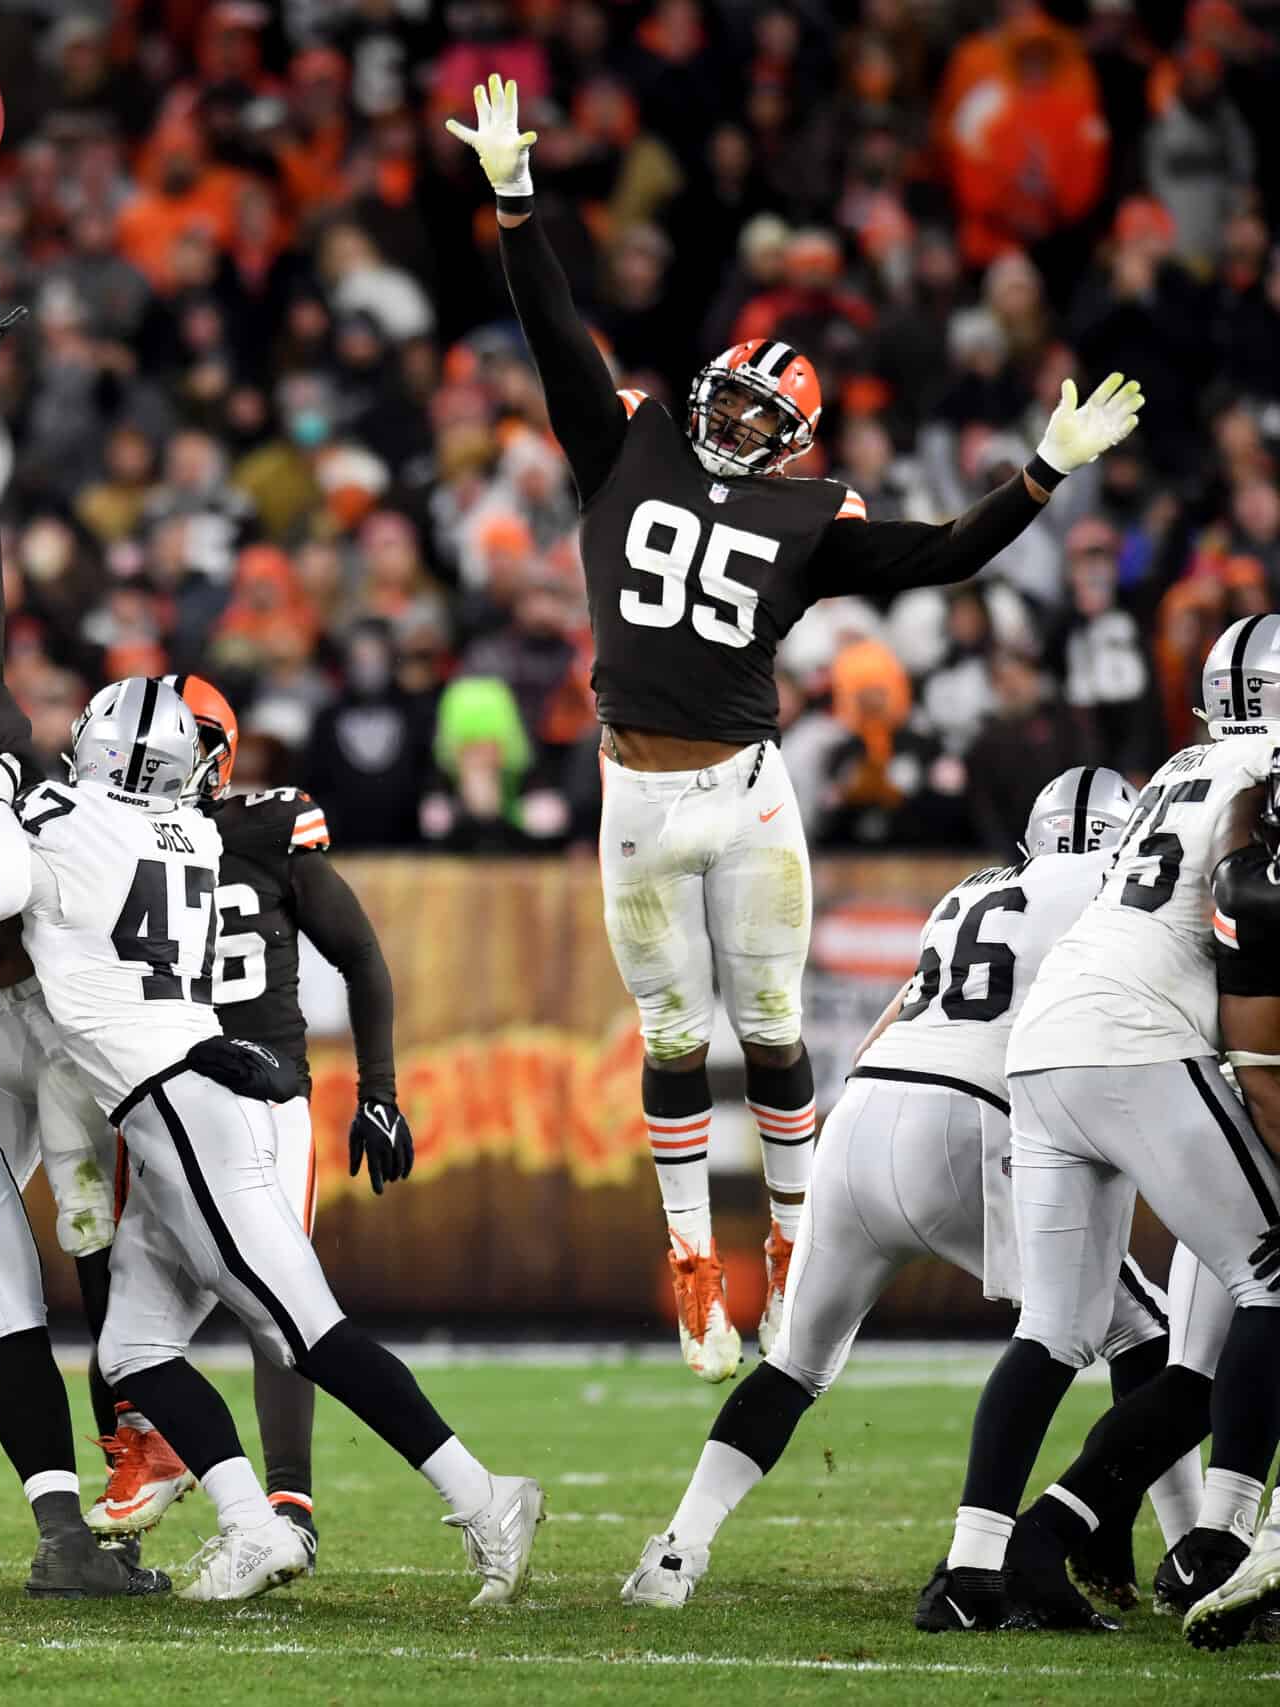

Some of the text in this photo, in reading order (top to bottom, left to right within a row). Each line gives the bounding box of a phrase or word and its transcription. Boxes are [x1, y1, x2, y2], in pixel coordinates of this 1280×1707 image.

[620, 500, 780, 648] 95
[1220, 699, 1263, 718] 75
[1221, 726, 1269, 736] RAIDERS
[109, 768, 155, 794] 47
[107, 791, 150, 808] RAIDERS
[110, 858, 218, 1006] 47
[894, 886, 1028, 1023] 66
[235, 1545, 273, 1580] adidas
